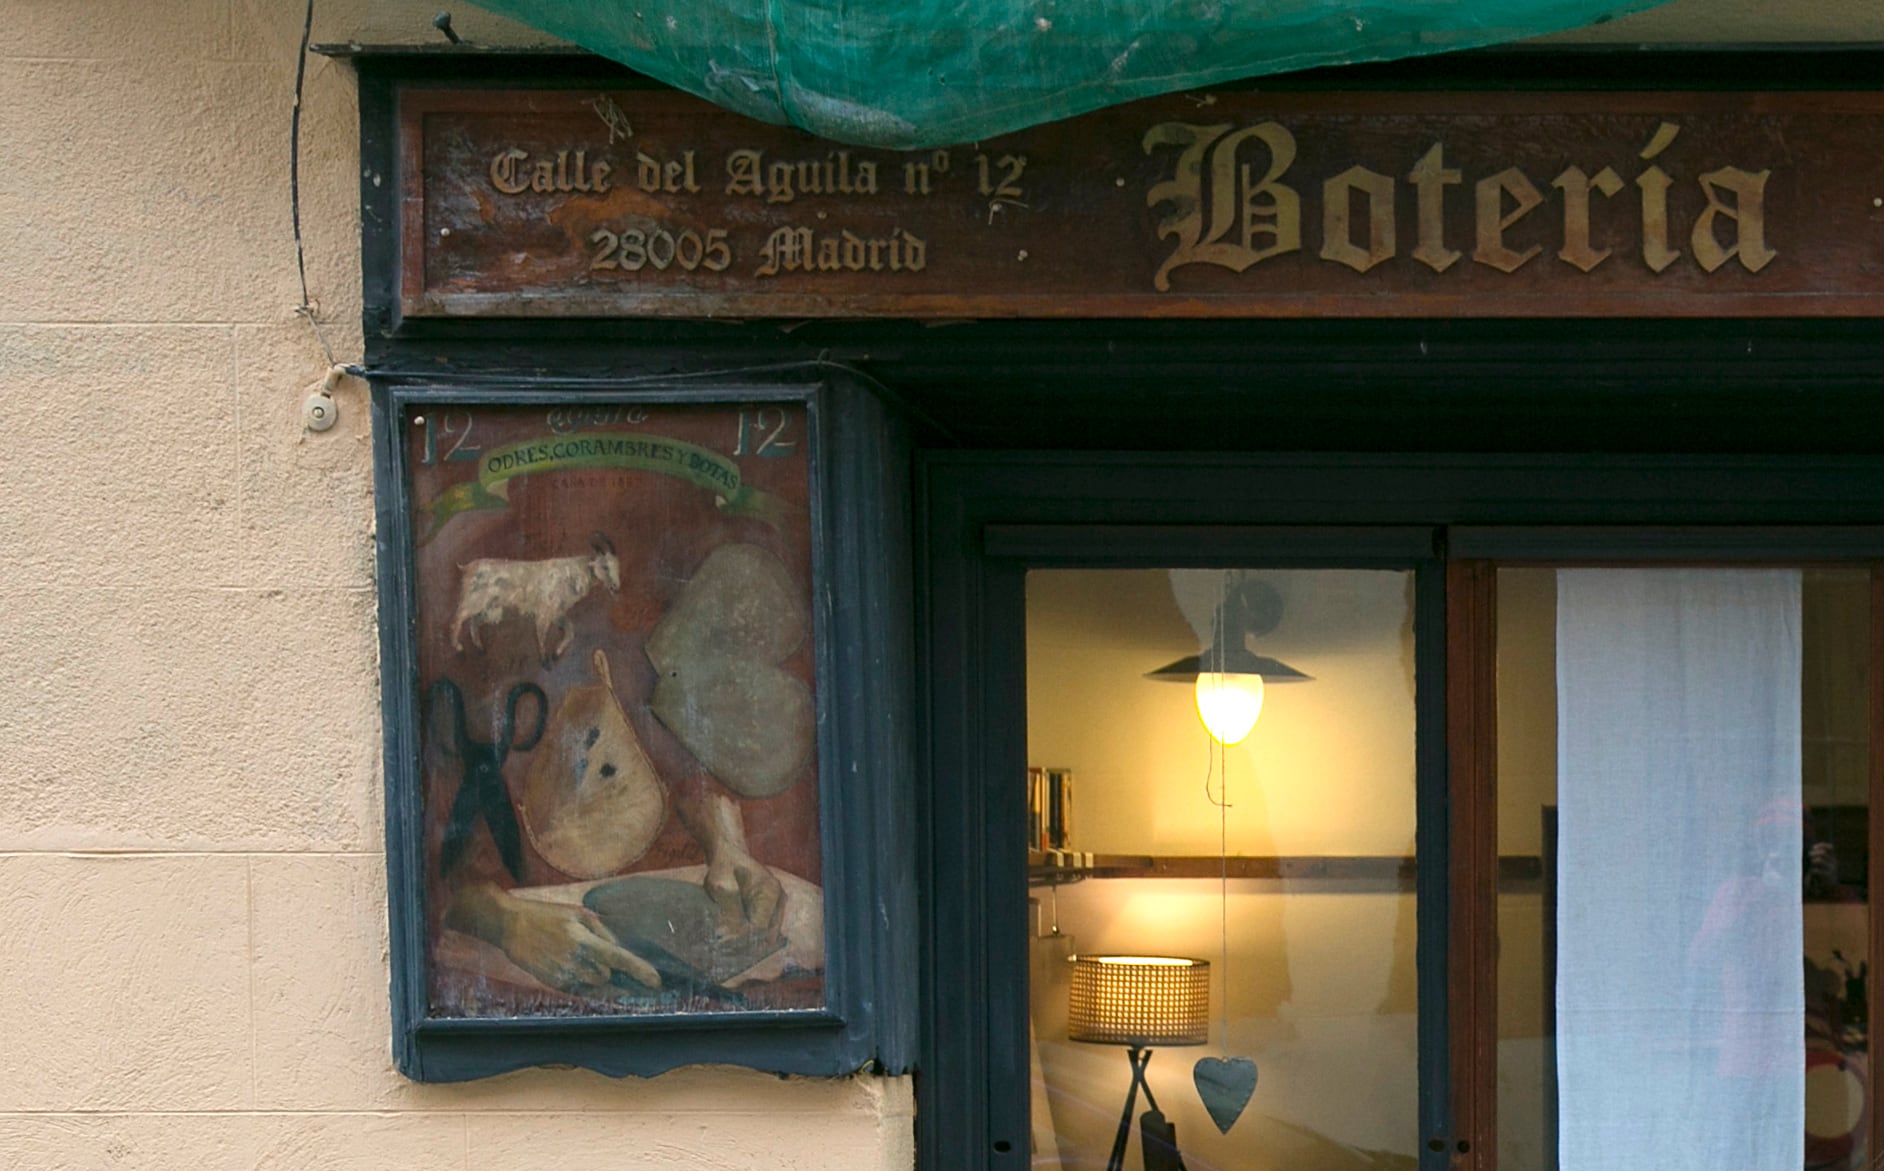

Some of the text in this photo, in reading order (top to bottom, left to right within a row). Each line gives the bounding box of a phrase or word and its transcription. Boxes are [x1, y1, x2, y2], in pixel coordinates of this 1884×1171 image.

[490, 148, 611, 197] Calle
[636, 149, 700, 196] del
[724, 149, 881, 204] Aguila
[975, 153, 1028, 198] 12
[1142, 120, 1778, 293] Botería
[590, 226, 927, 279] 28005 Madrid
[421, 411, 481, 464] 12
[733, 405, 799, 459] 12
